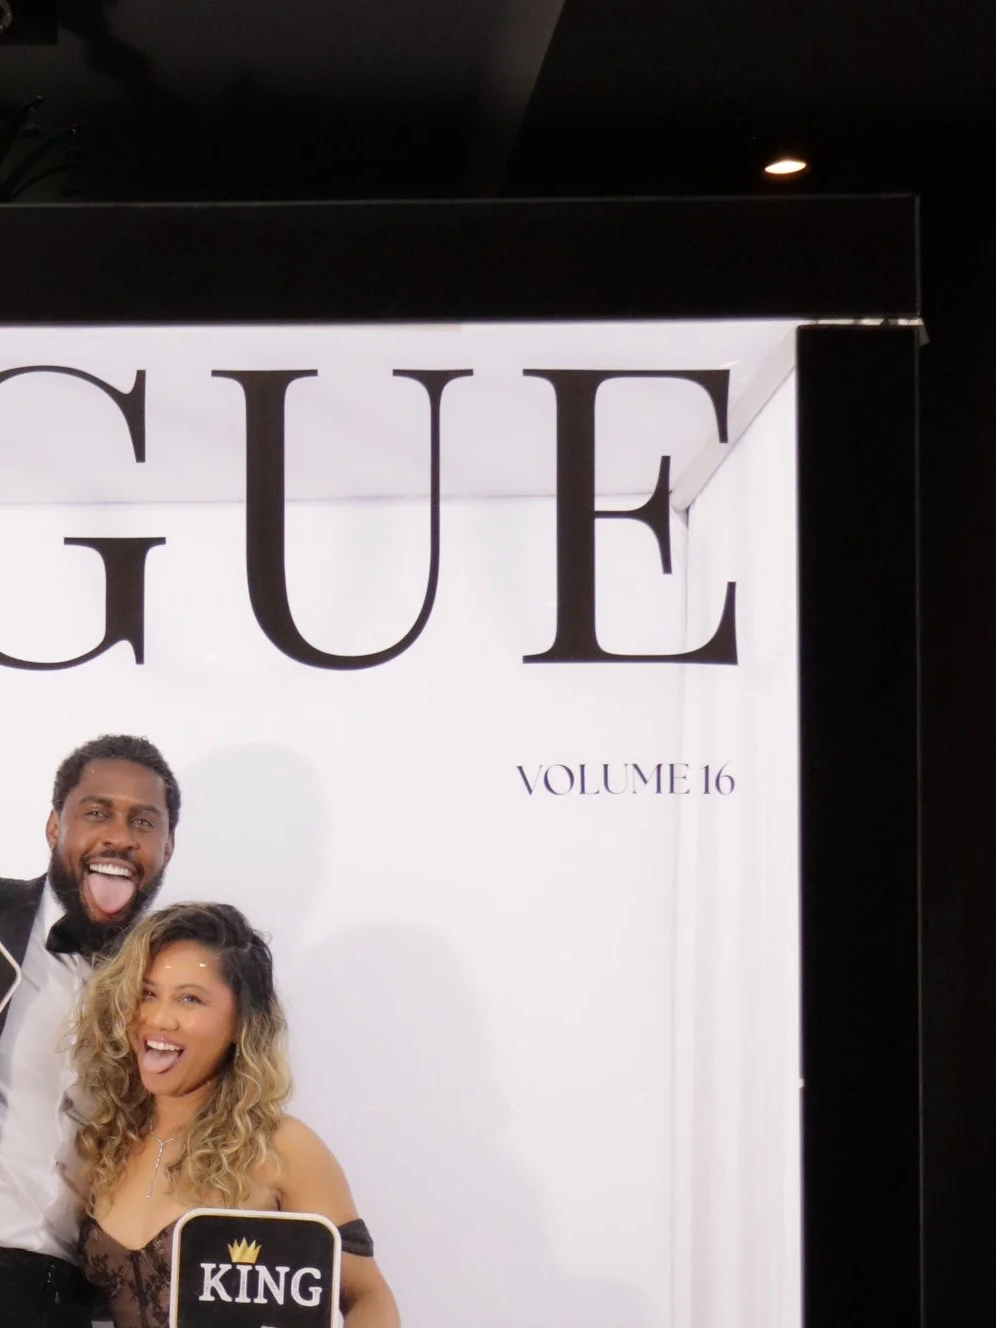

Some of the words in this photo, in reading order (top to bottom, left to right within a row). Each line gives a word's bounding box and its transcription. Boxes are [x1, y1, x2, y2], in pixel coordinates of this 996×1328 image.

[515, 763, 691, 796] VOLUME
[701, 760, 736, 796] 16
[198, 1262, 324, 1308] KING
